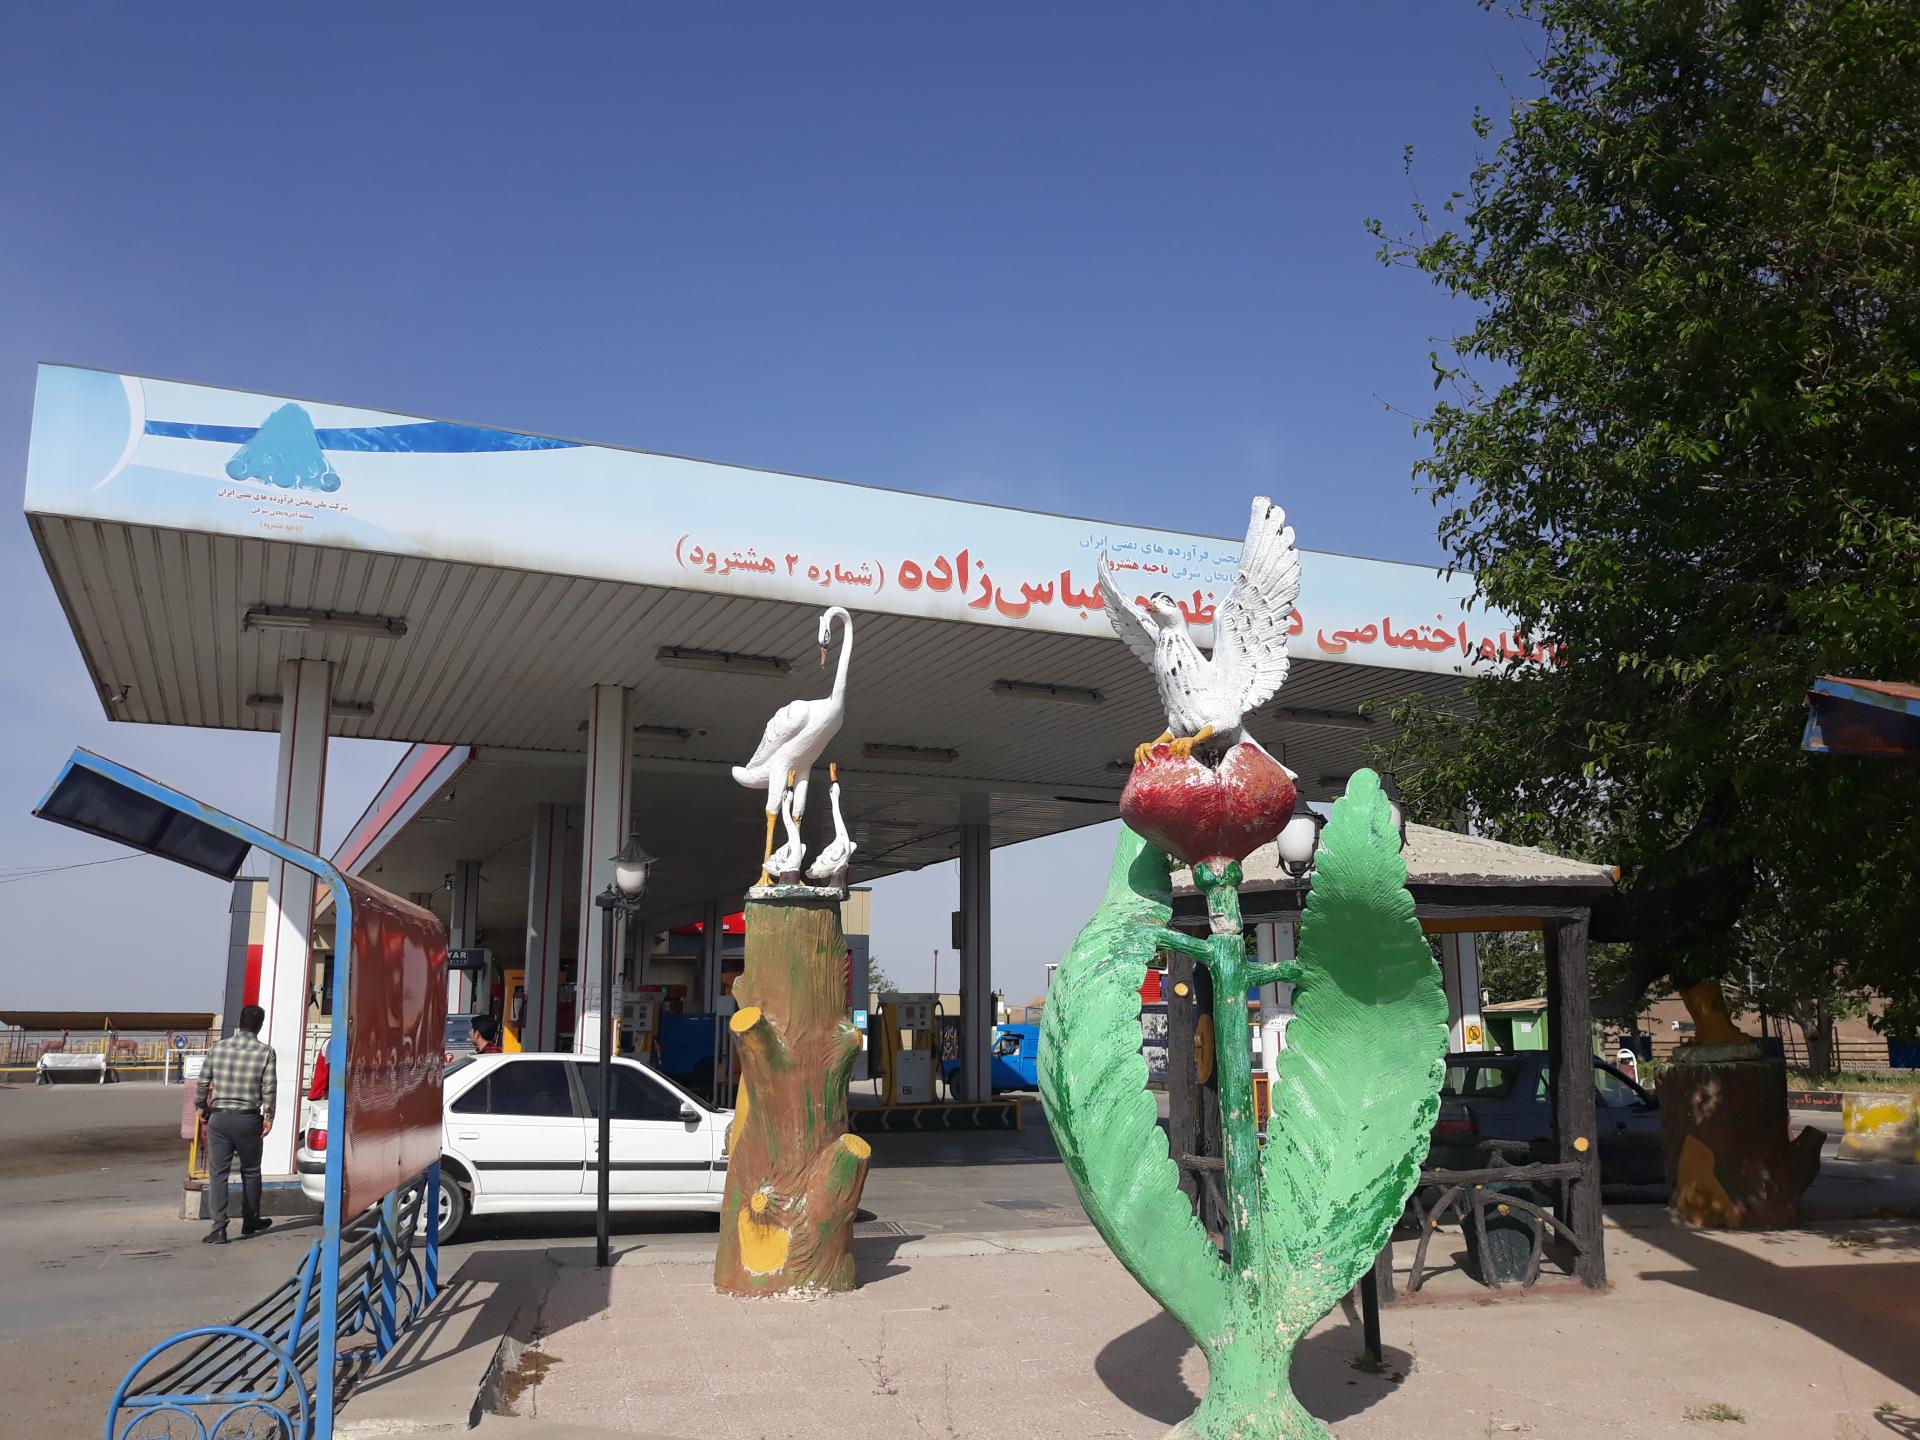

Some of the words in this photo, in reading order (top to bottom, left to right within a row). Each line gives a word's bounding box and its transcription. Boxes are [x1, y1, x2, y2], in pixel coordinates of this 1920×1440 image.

[218, 488, 235, 498] ایران
[328, 503, 349, 511] شرکت
[1079, 534, 1108, 550] ایران
[1111, 538, 1137, 552] نفتی
[1140, 542, 1164, 555] های
[674, 533, 777, 576] هشترود)
[1167, 544, 1209, 562] فرآورده
[784, 551, 799, 577] ۲
[1109, 556, 1139, 572] هشترو
[1142, 561, 1168, 576] ناحیه
[807, 558, 885, 596] (شماره
[1171, 567, 1201, 581] شرقی
[1316, 613, 1468, 656] اختصاصی
[447, 951, 467, 959] YAR
